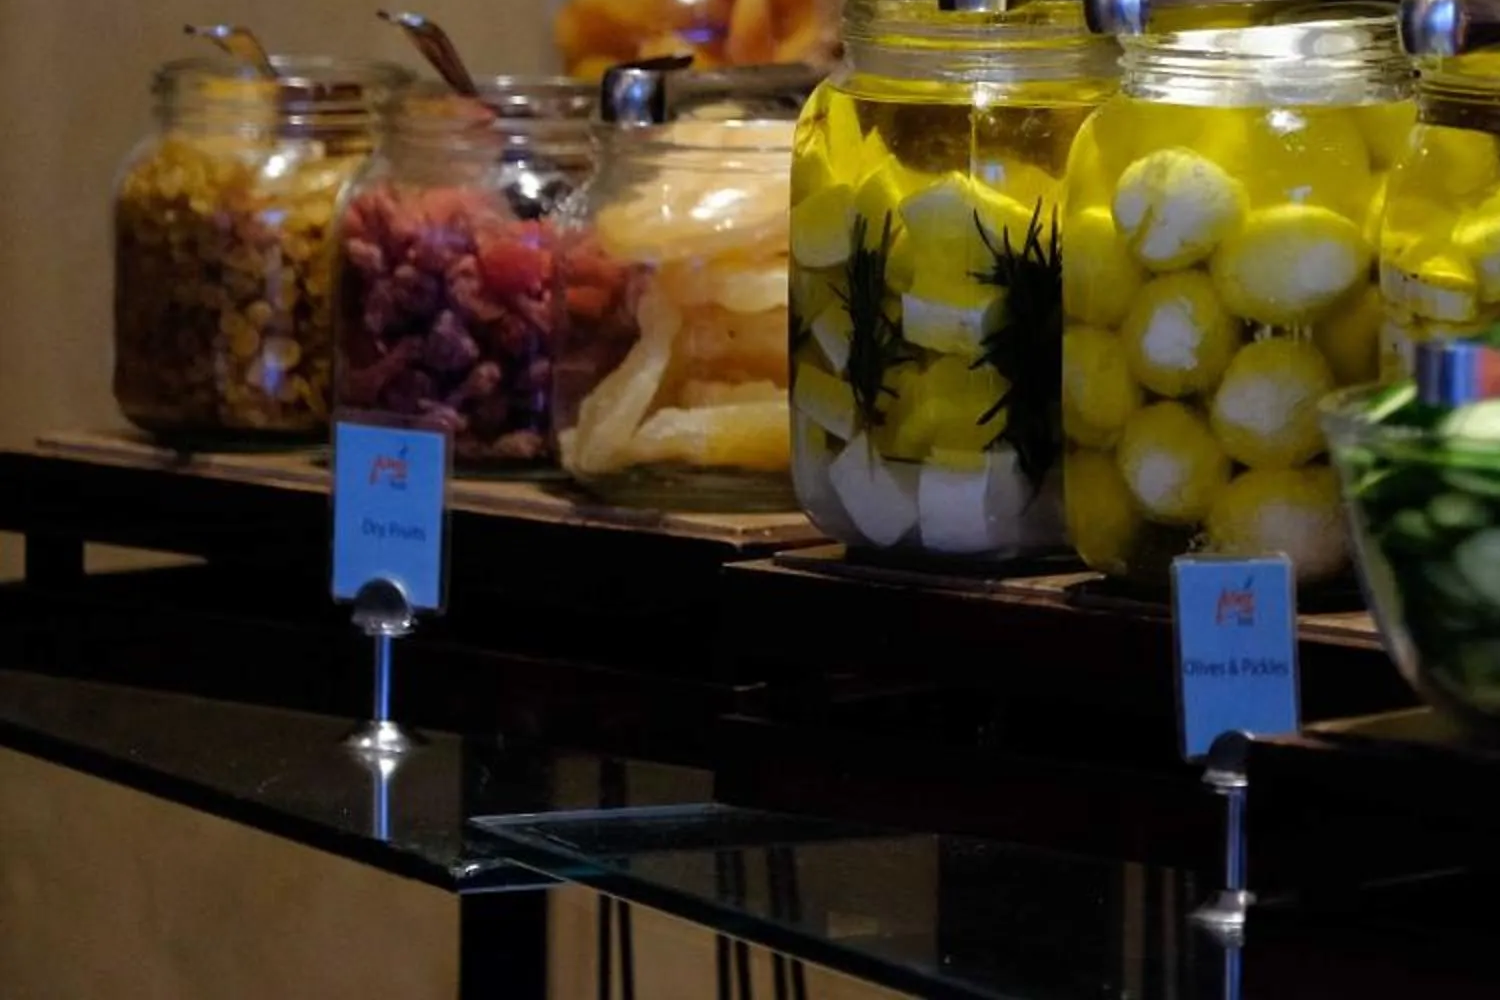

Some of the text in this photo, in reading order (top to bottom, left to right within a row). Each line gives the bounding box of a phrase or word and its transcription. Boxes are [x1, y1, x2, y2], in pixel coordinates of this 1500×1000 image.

[362, 517, 427, 542] Dry Fruits
[1183, 658, 1225, 676] Olives
[1242, 657, 1290, 676] Pickles
